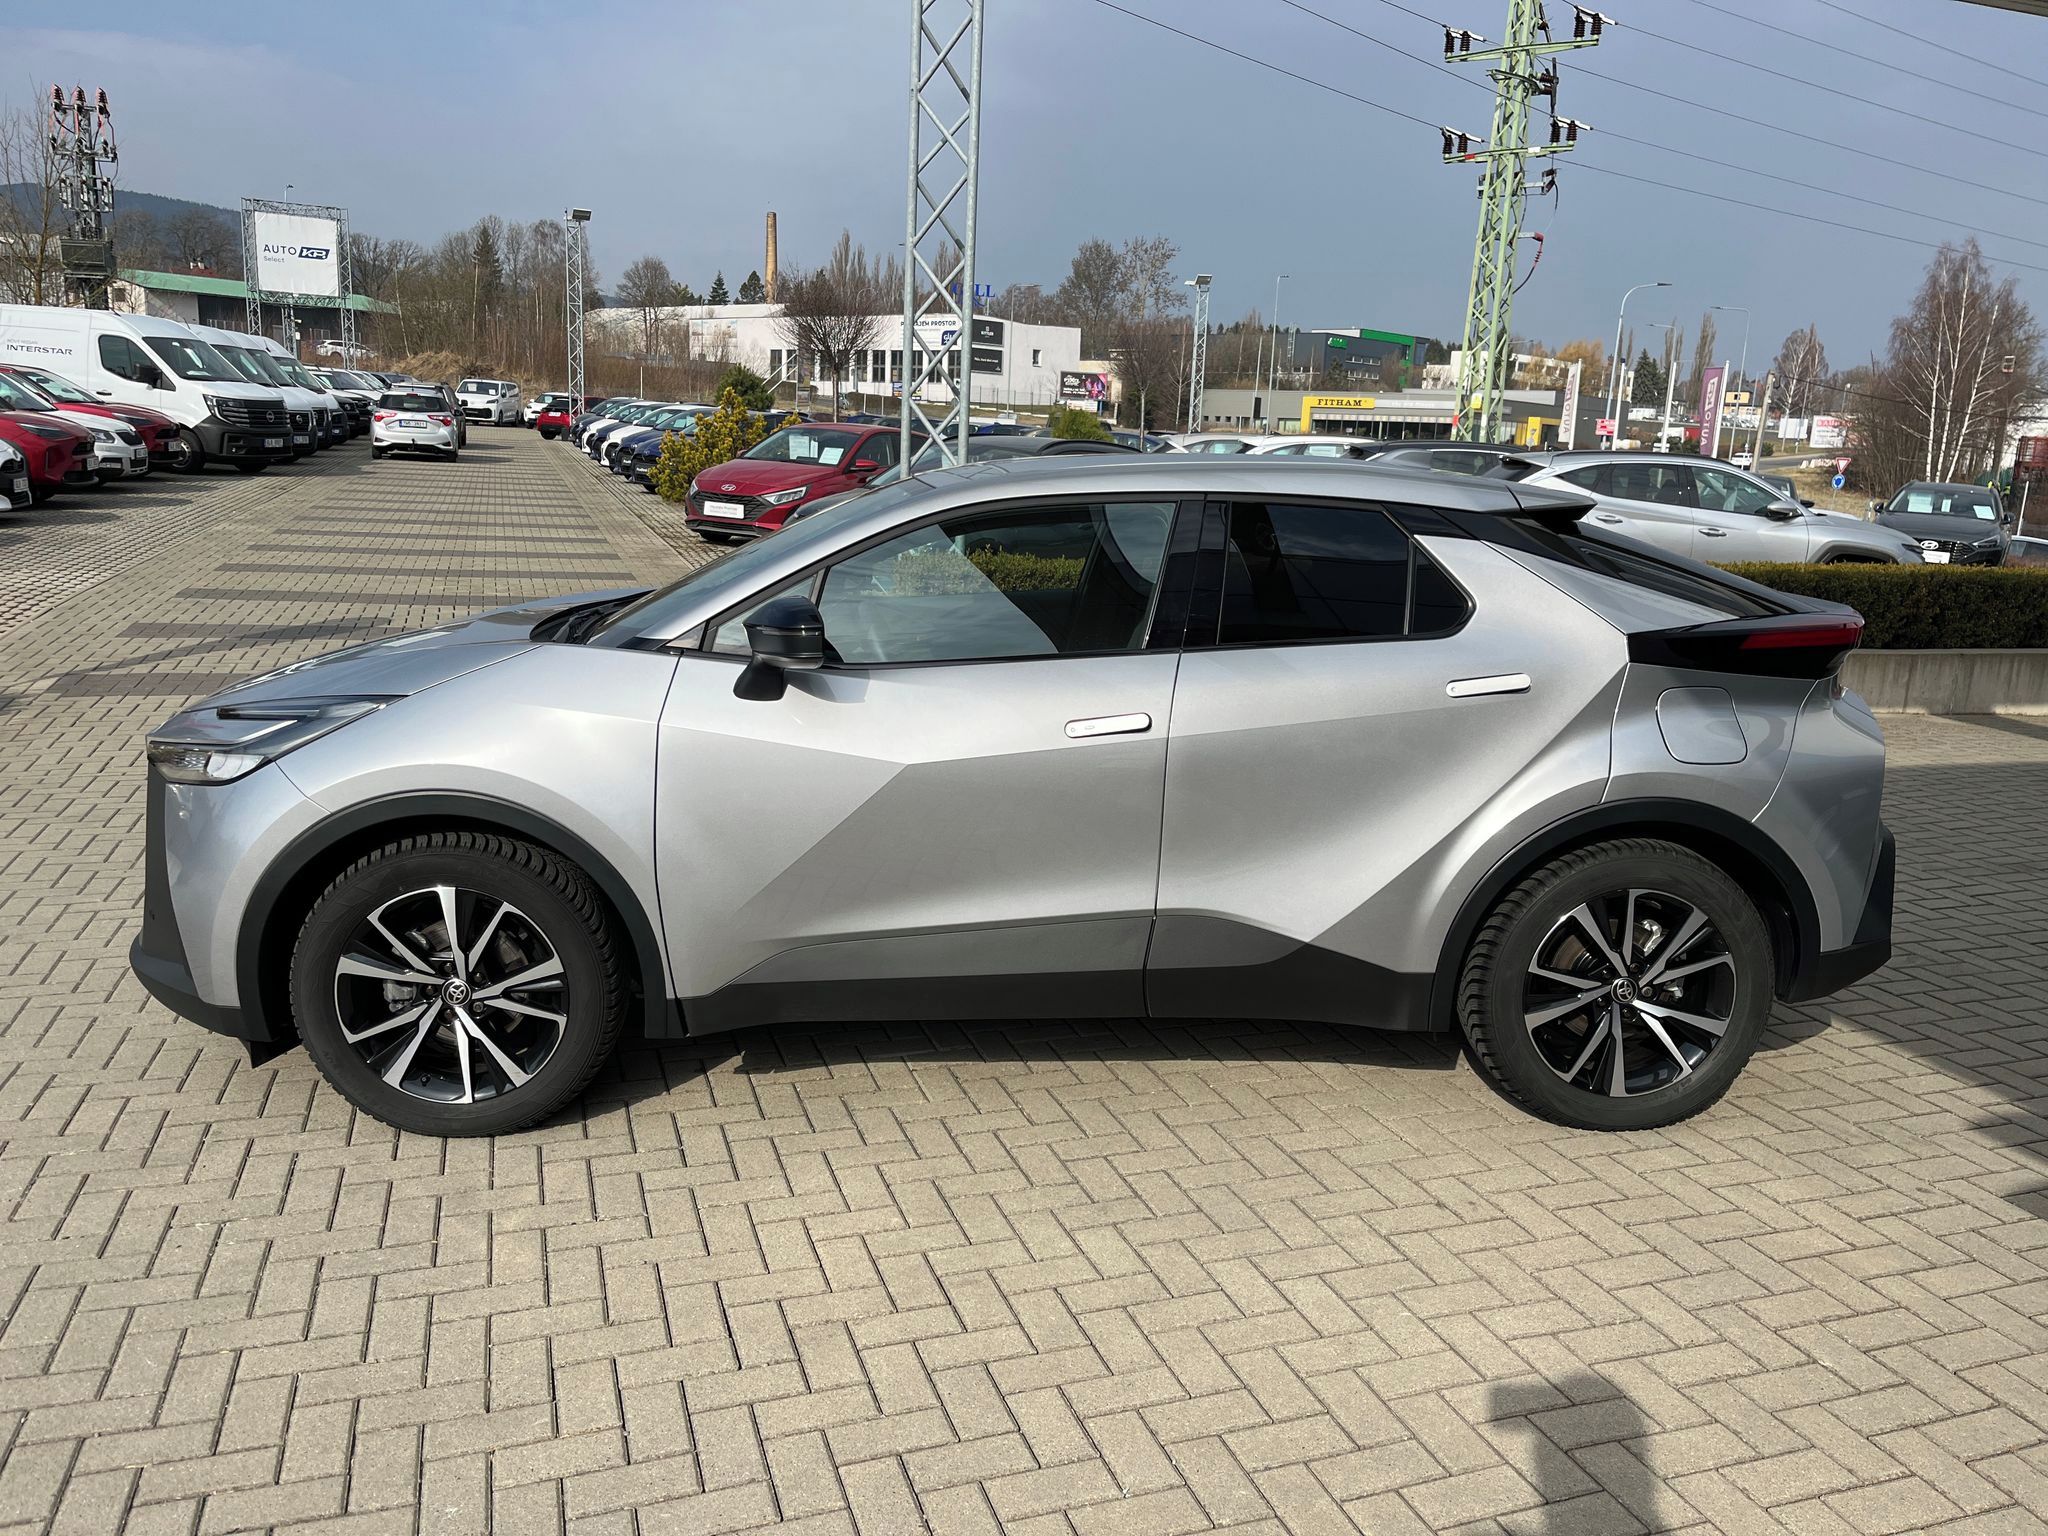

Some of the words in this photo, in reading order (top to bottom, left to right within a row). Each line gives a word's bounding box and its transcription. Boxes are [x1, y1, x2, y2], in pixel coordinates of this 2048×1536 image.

[263, 244, 297, 255] AUTO
[263, 255, 285, 263] Select
[6, 344, 73, 355] INTERSTAR
[1317, 398, 1362, 407] FITHAM
